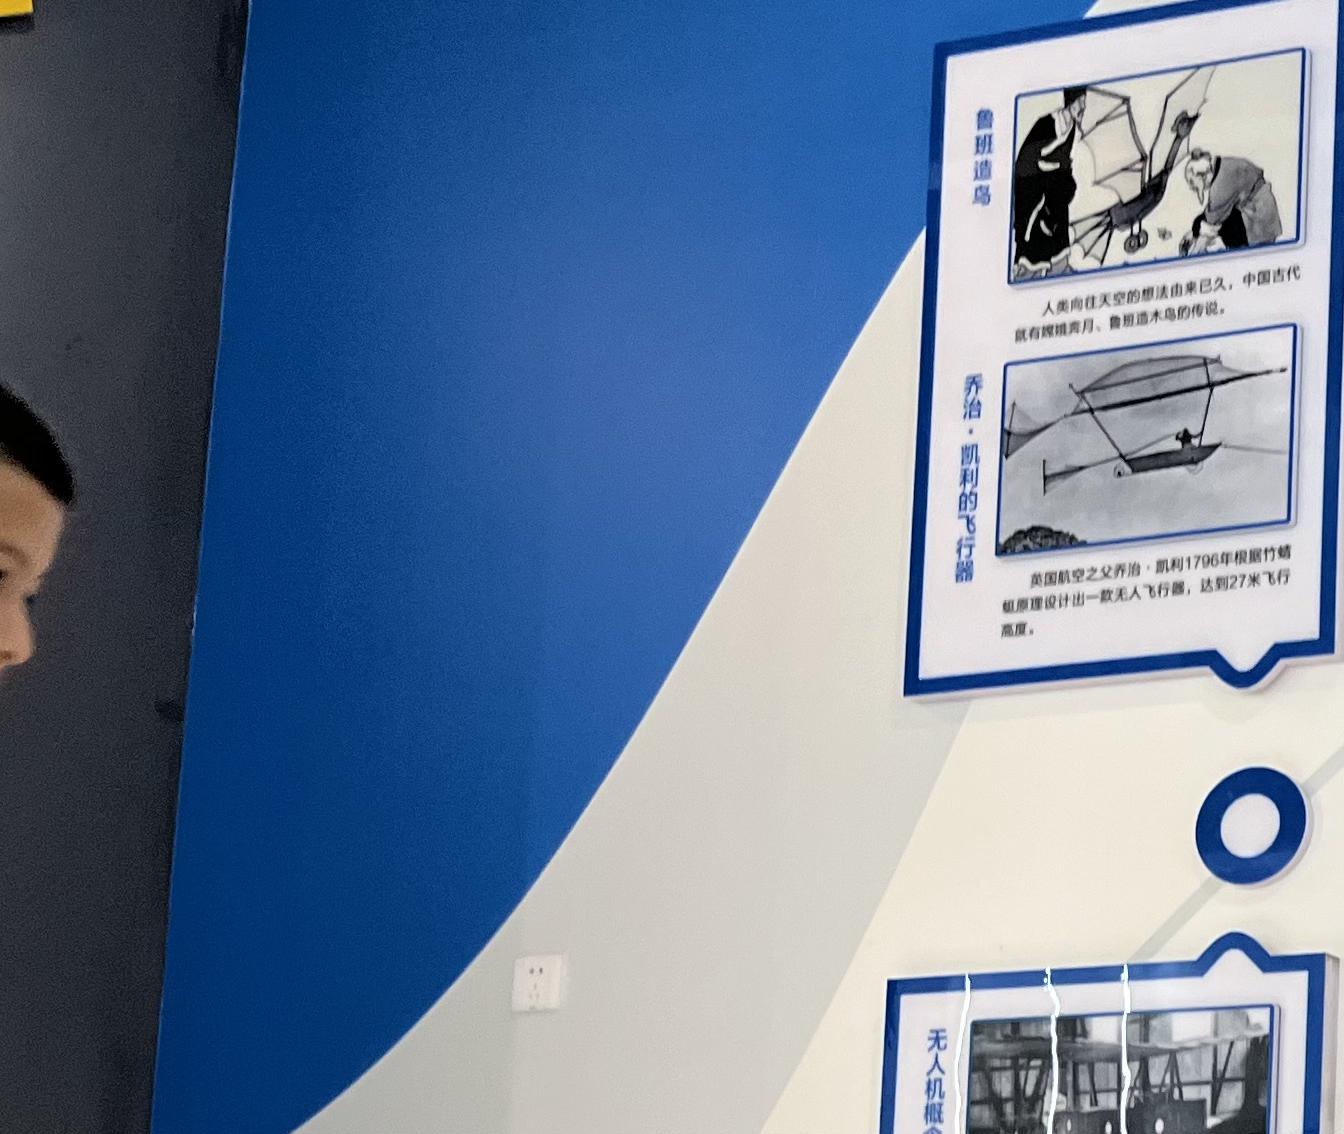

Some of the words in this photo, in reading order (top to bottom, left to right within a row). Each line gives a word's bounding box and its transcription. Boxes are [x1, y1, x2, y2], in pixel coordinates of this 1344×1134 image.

[971, 107, 995, 206] 鲁班造鸟
[1042, 266, 1301, 317] 人类向往天空的想法由来已久，中国古代
[1000, 622, 1035, 638] 高度。
